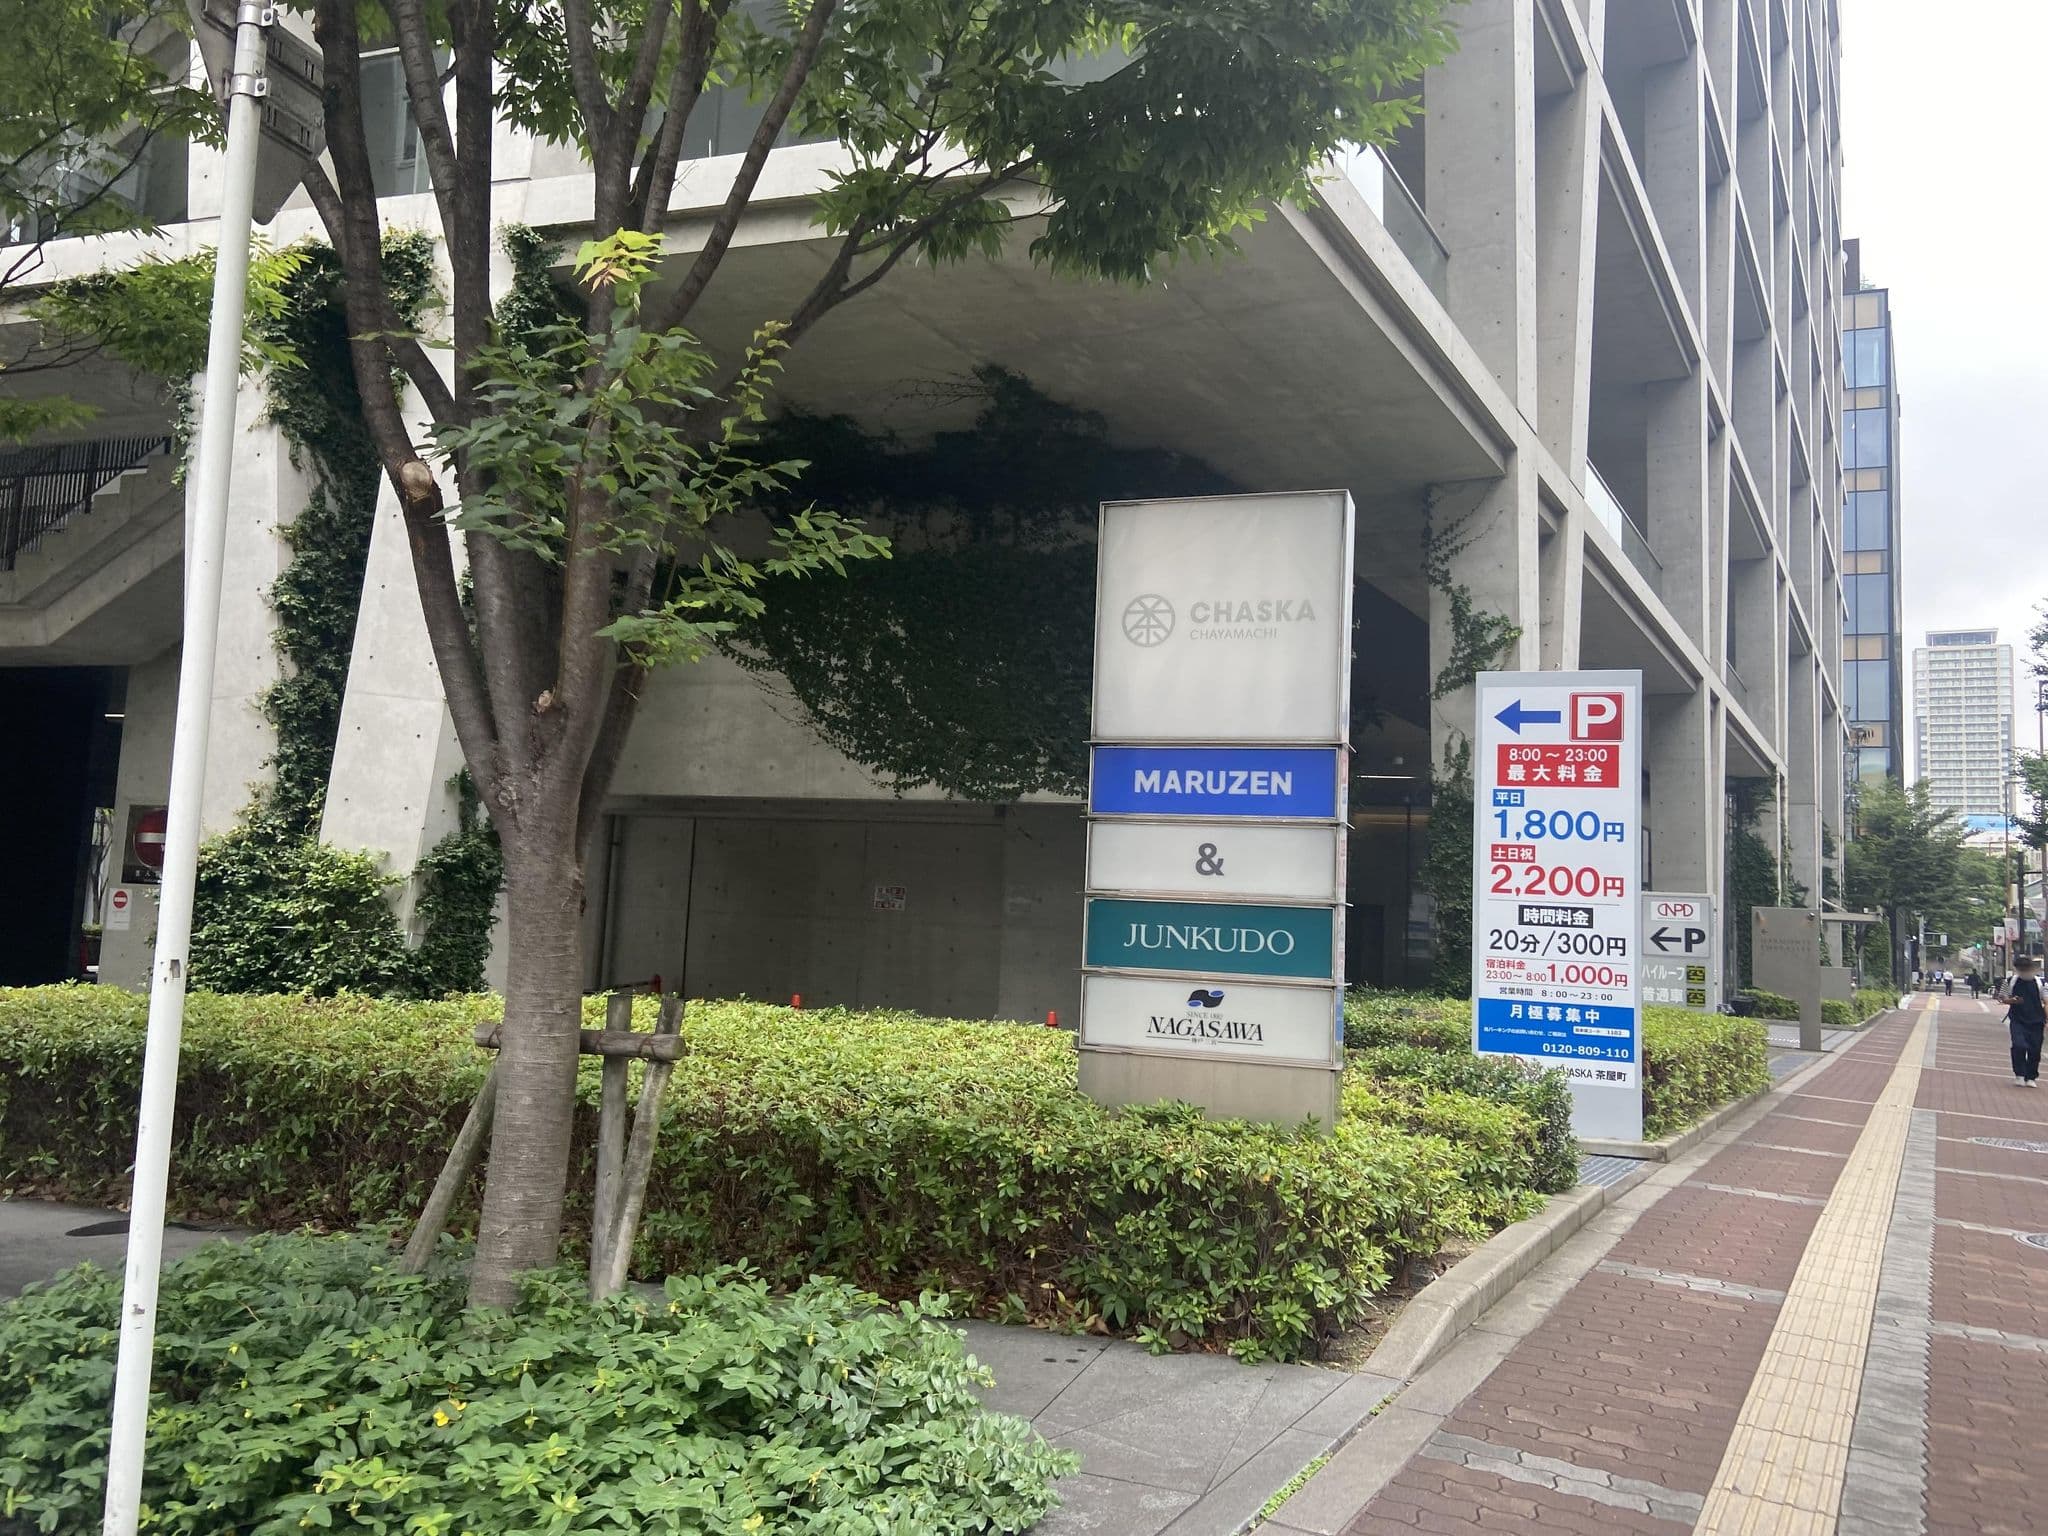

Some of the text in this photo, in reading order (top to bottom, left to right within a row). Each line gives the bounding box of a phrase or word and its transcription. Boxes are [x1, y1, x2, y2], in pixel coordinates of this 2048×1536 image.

[1190, 599, 1316, 623] CHASKA
[1190, 628, 1278, 641] CHAYAMACHI
[1577, 696, 1617, 738] P
[1134, 769, 1292, 796] MARUZEN
[1507, 765, 1603, 782] 最大料金
[1495, 791, 1521, 805] 平日
[1494, 809, 1625, 843] 1,800円
[1195, 842, 1225, 876] &
[1493, 847, 1534, 861] 土日祝
[1491, 864, 1625, 898] 2,200円
[1523, 908, 1590, 926] 時間料金
[1123, 923, 1295, 955] JUNKUDO
[1684, 927, 1706, 953] P
[1486, 959, 1526, 970] 宿泊料金
[1641, 964, 1685, 981] ハイルーフ
[1547, 963, 1628, 988] 1,000円
[1499, 986, 1533, 996] 営業時間
[1641, 986, 1684, 1004] 普通車
[1510, 1004, 1600, 1024] 月極募集中
[1147, 1016, 1264, 1042] NAGASAWA
[1542, 1043, 1629, 1059] 0120-809-110
[1595, 1070, 1626, 1082] 茶屋町
